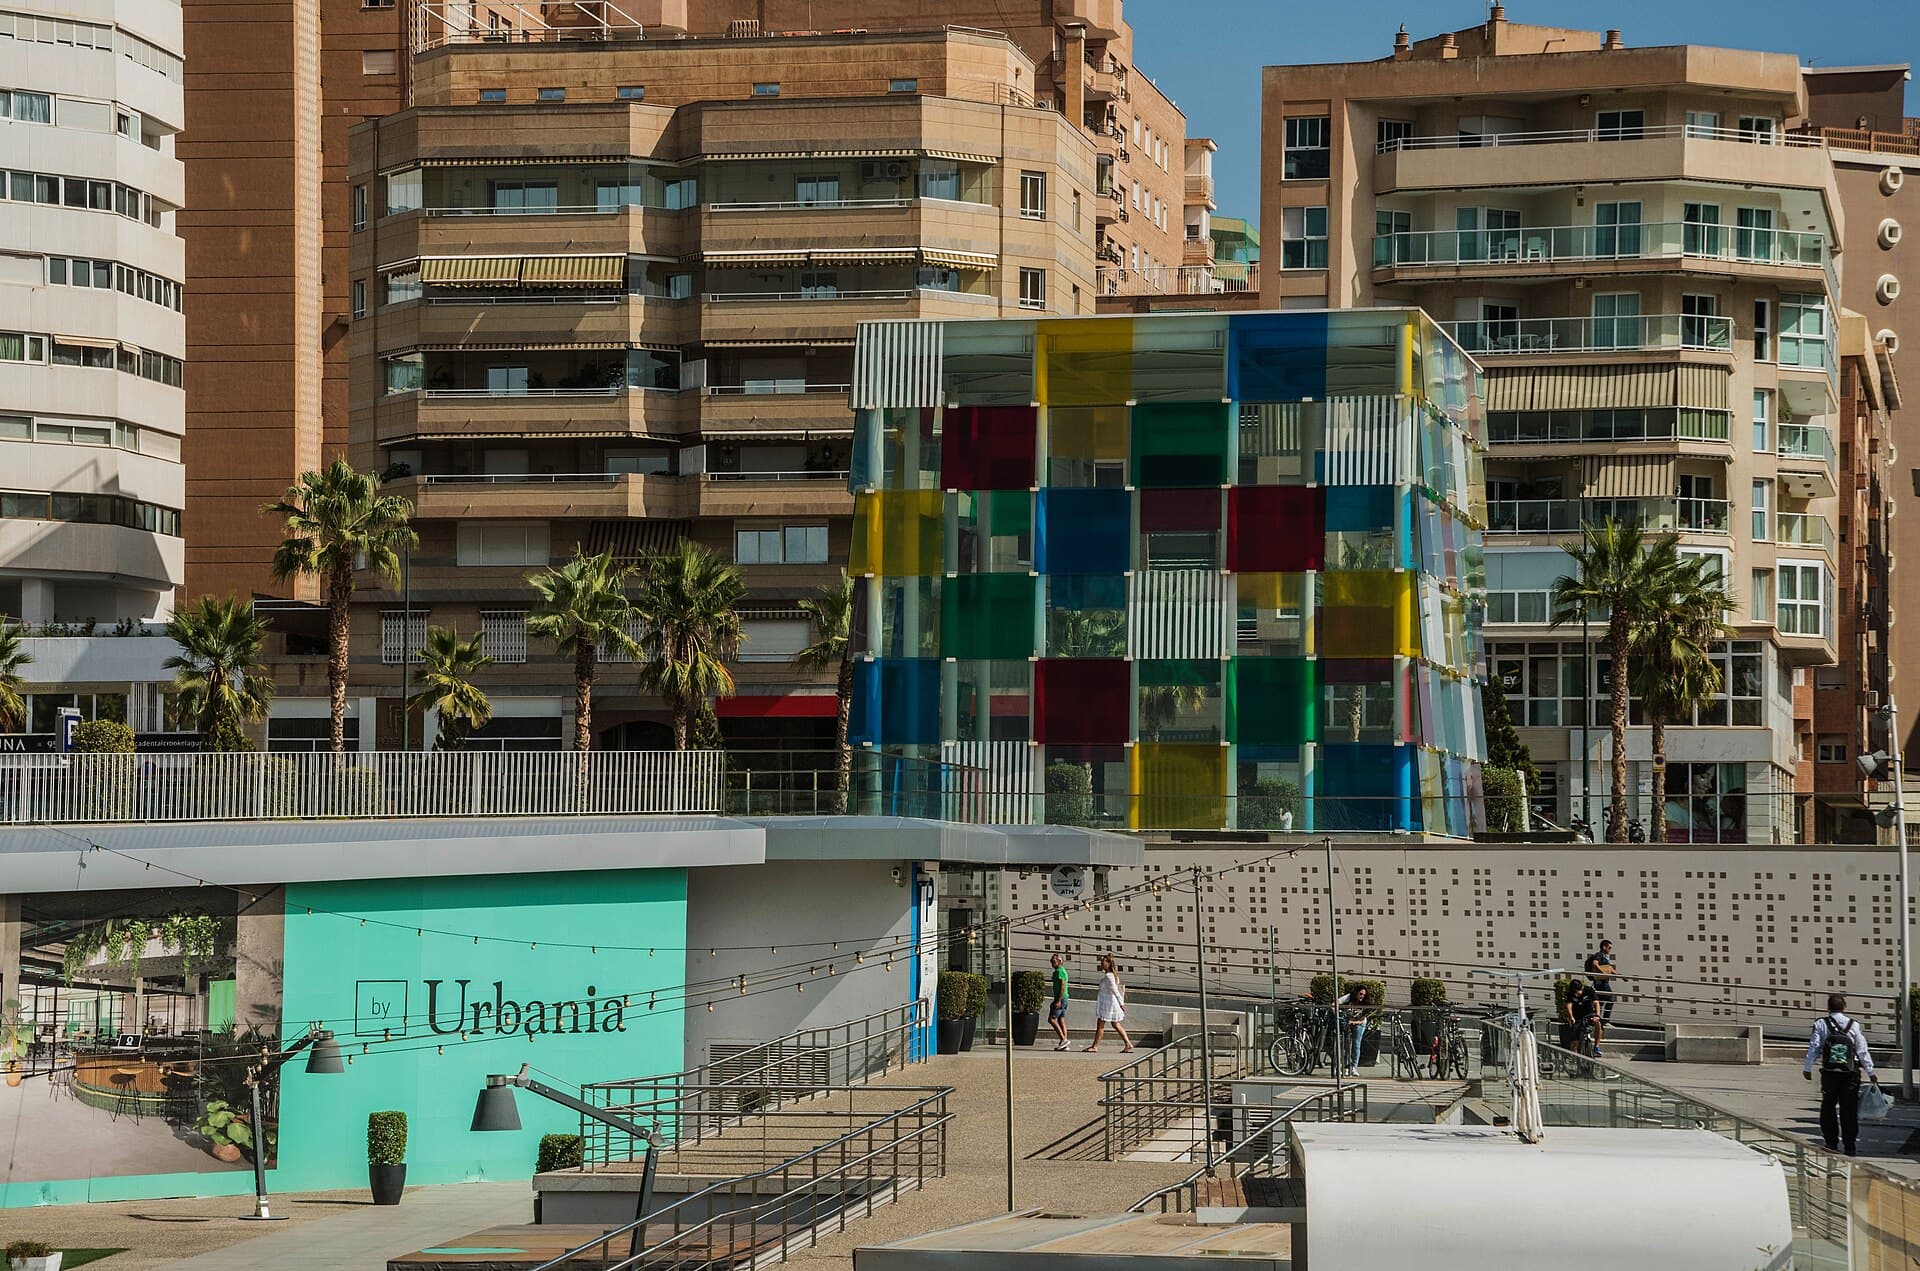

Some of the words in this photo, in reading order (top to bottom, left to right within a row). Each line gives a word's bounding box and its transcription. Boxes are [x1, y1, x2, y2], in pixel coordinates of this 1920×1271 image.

[1503, 676, 1517, 685] EY
[0, 738, 26, 751] NA
[371, 996, 391, 1019] by
[423, 979, 627, 1035] Urbania
